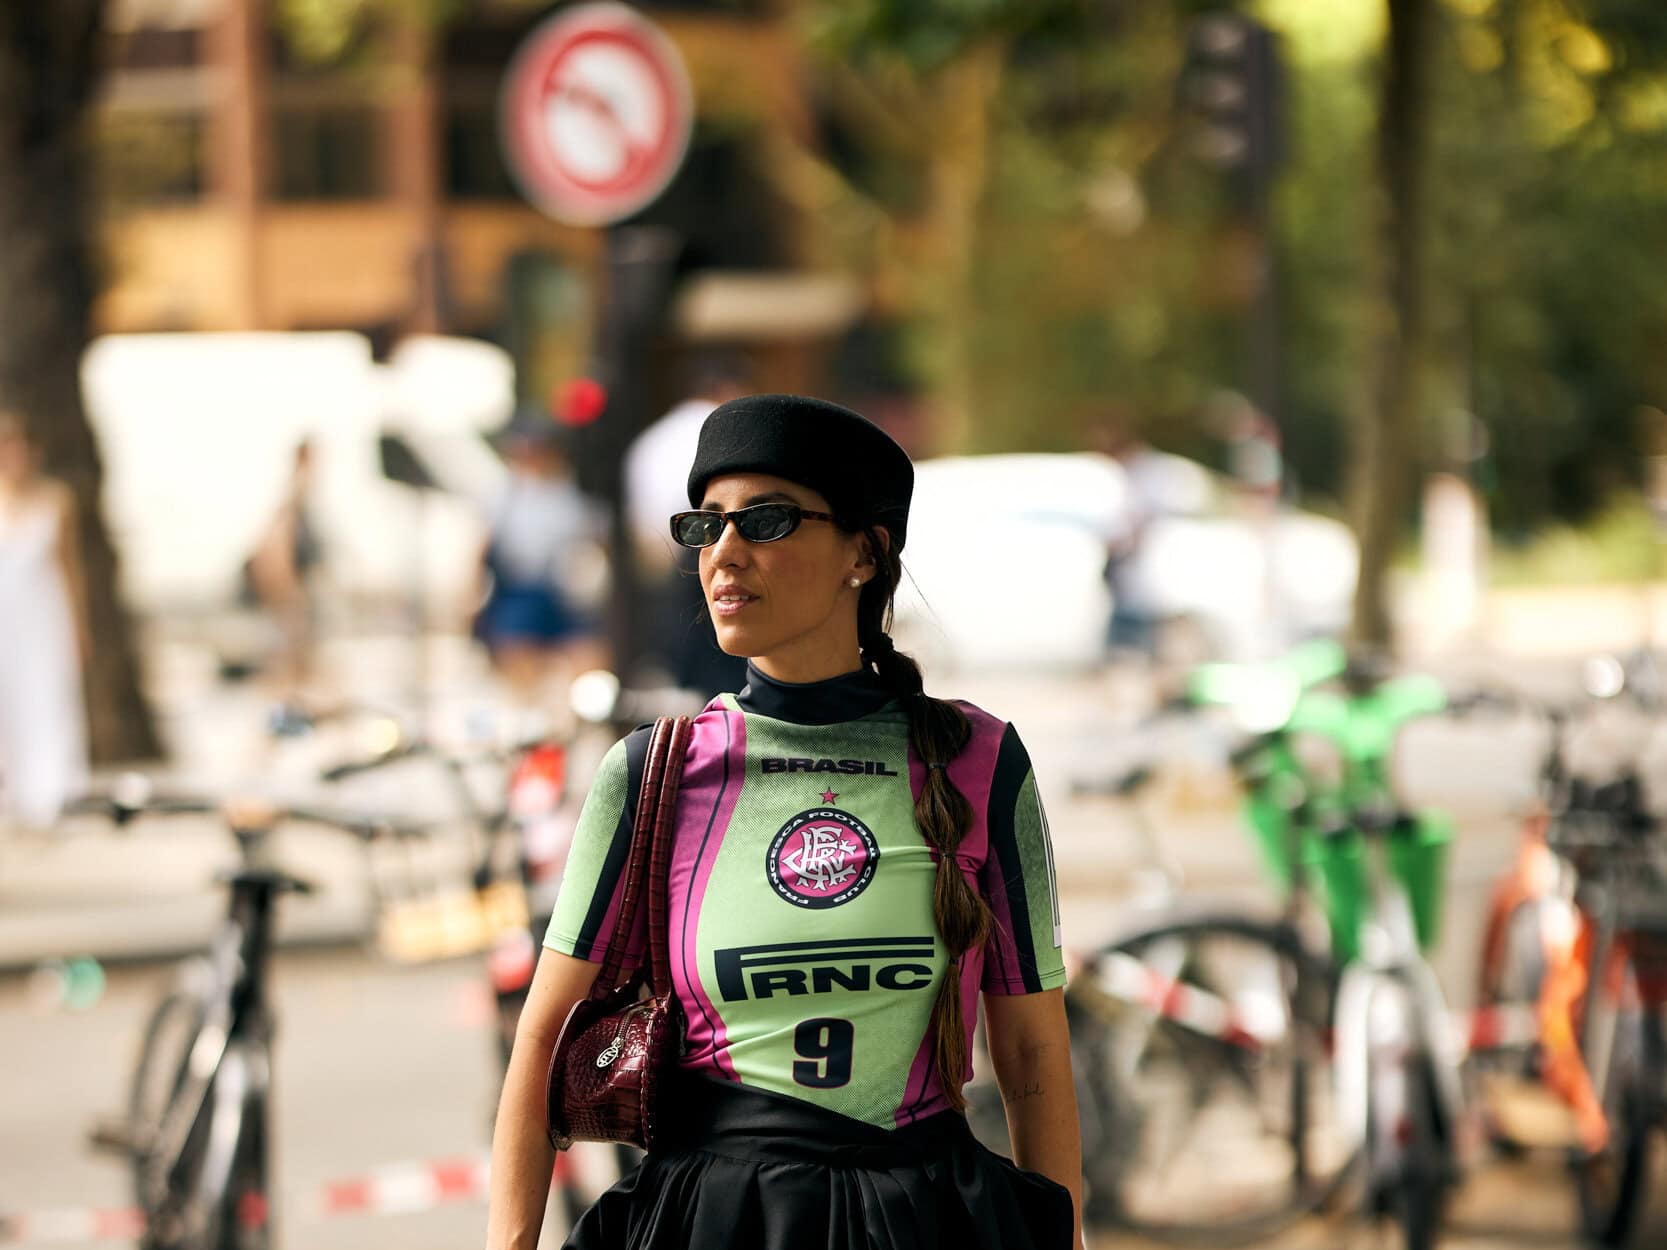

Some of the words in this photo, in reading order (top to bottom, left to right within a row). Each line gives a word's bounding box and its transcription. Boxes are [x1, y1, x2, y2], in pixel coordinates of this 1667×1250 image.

[761, 758, 898, 776] BRASIL
[769, 818, 809, 905] FRANCESCA
[833, 866, 872, 903] CLUB
[792, 1017, 854, 1089] 9
